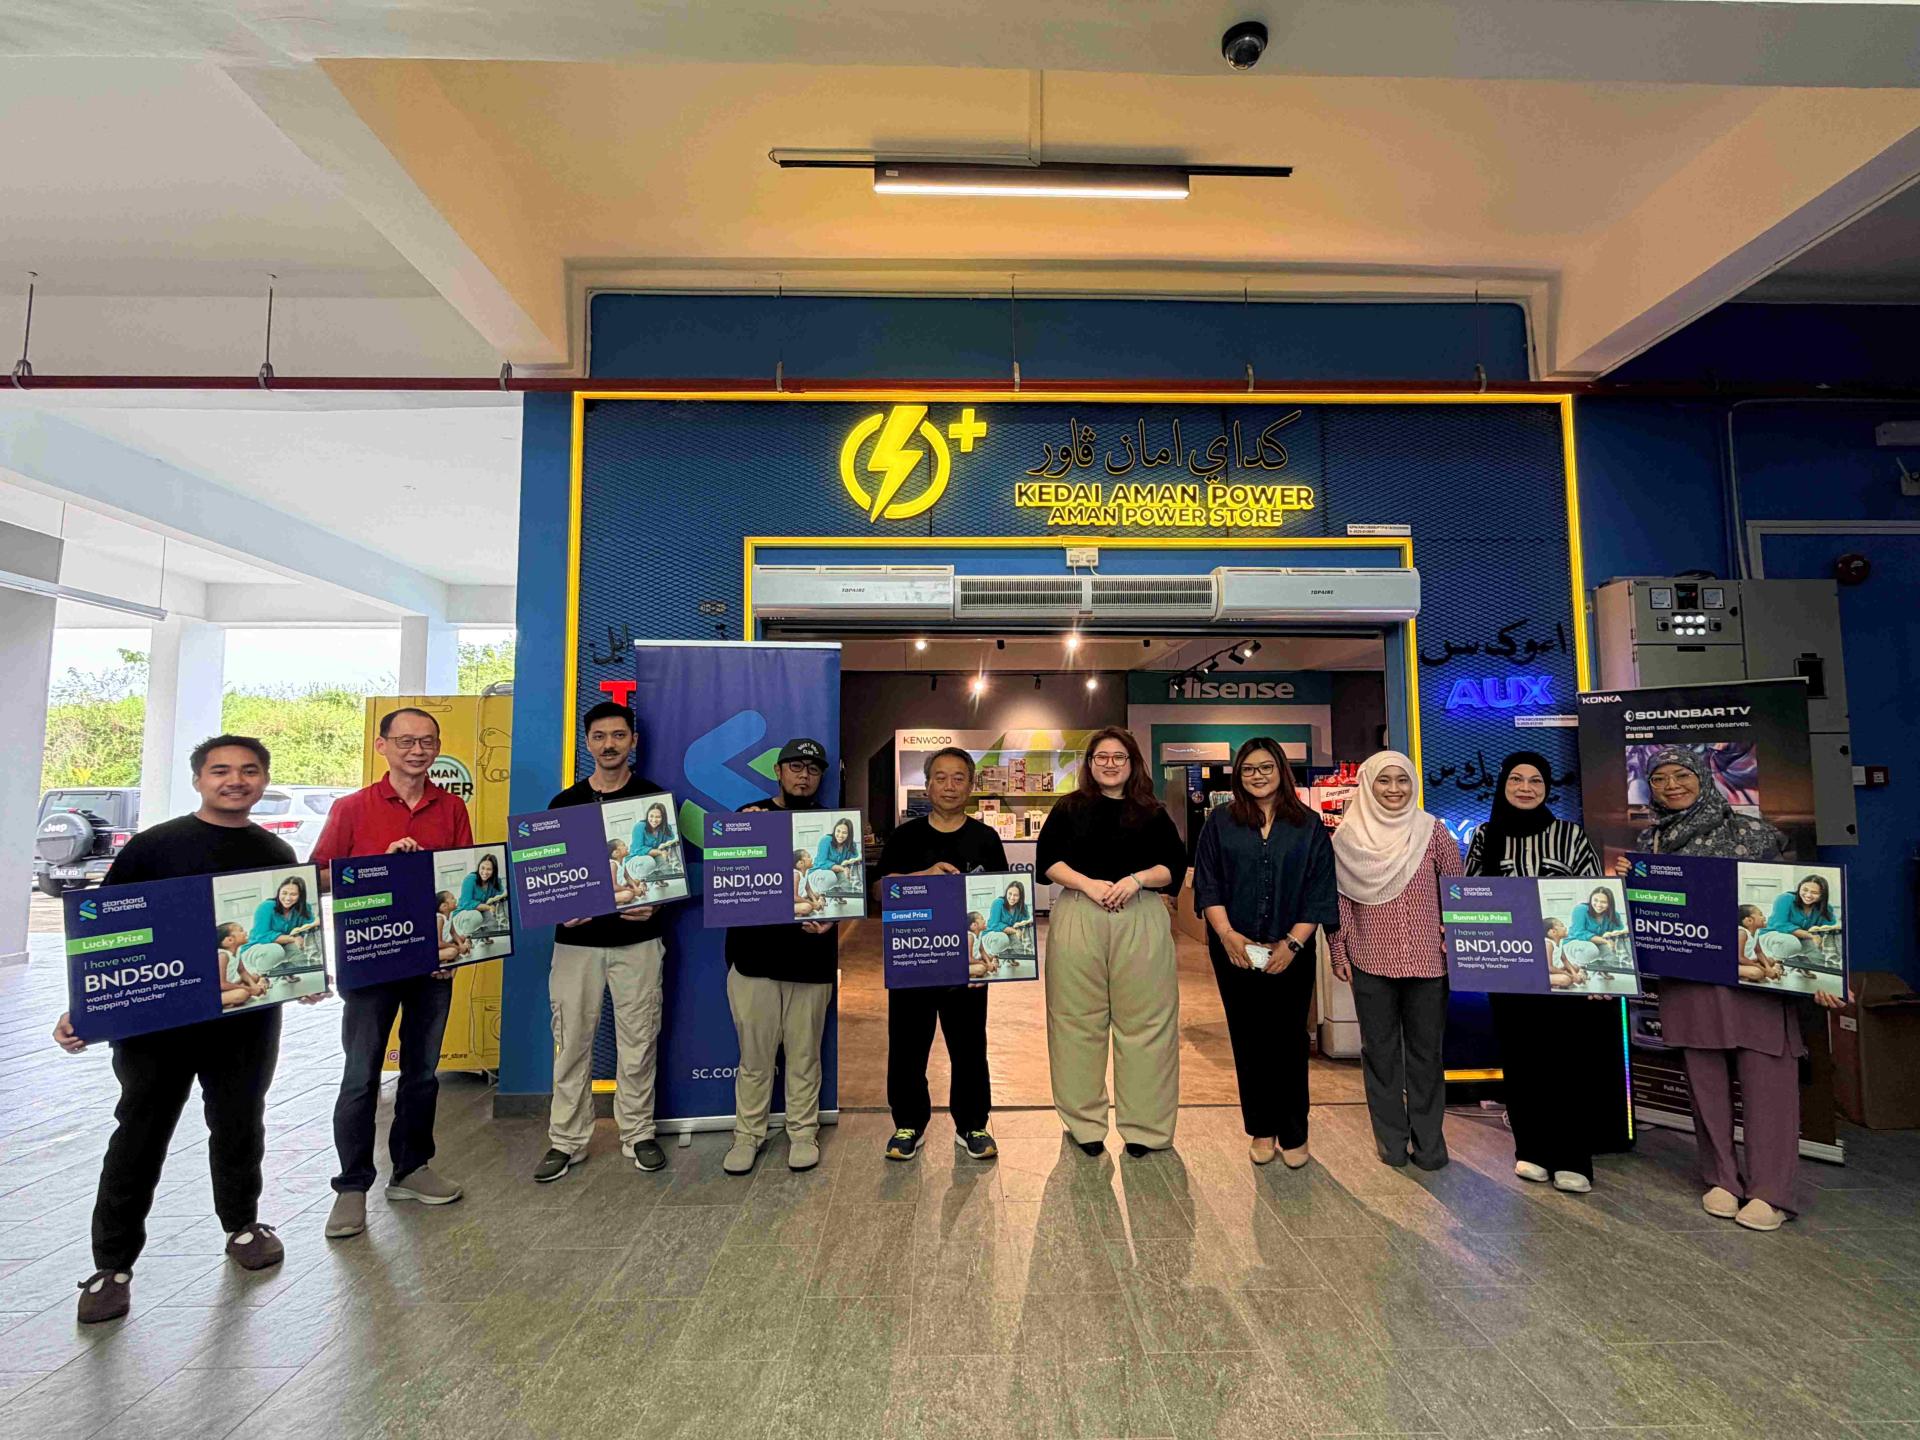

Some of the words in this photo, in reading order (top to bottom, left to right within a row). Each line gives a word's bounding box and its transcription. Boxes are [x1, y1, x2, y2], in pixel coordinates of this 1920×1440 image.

[1105, 418, 1183, 475] امان
[1016, 483, 1100, 506] KEDAI
[1109, 485, 1198, 506] AMAN
[1208, 486, 1314, 509] POWER
[1049, 506, 1119, 525] AMAN
[1126, 506, 1206, 526] POWER
[1209, 507, 1282, 526] STORE
[1169, 677, 1295, 698] Hisense
[1445, 675, 1556, 709] AUX
[1582, 695, 1622, 704] KONKA
[903, 736, 952, 744] KENWOOD
[44, 824, 67, 832] Jeep
[526, 867, 588, 890] BND500
[713, 873, 782, 888] BND1,000
[345, 921, 414, 944] BND500
[1635, 919, 1708, 939] BND500
[82, 938, 115, 949] Lucky
[117, 934, 143, 944] Prize
[892, 935, 959, 950] BND2,000
[1456, 939, 1532, 955] BND1,000
[1636, 942, 1665, 951] Shopping
[1666, 945, 1692, 953] Voucher
[90, 958, 119, 969] have
[121, 954, 146, 964] won
[347, 952, 376, 961] Shopping
[85, 960, 184, 992] BND500
[86, 993, 112, 1003] worth
[125, 986, 152, 996] Aman
[153, 981, 178, 990] Power
[180, 977, 202, 986] Store
[86, 999, 129, 1012] Shopping
[131, 992, 166, 1003] Voucher
